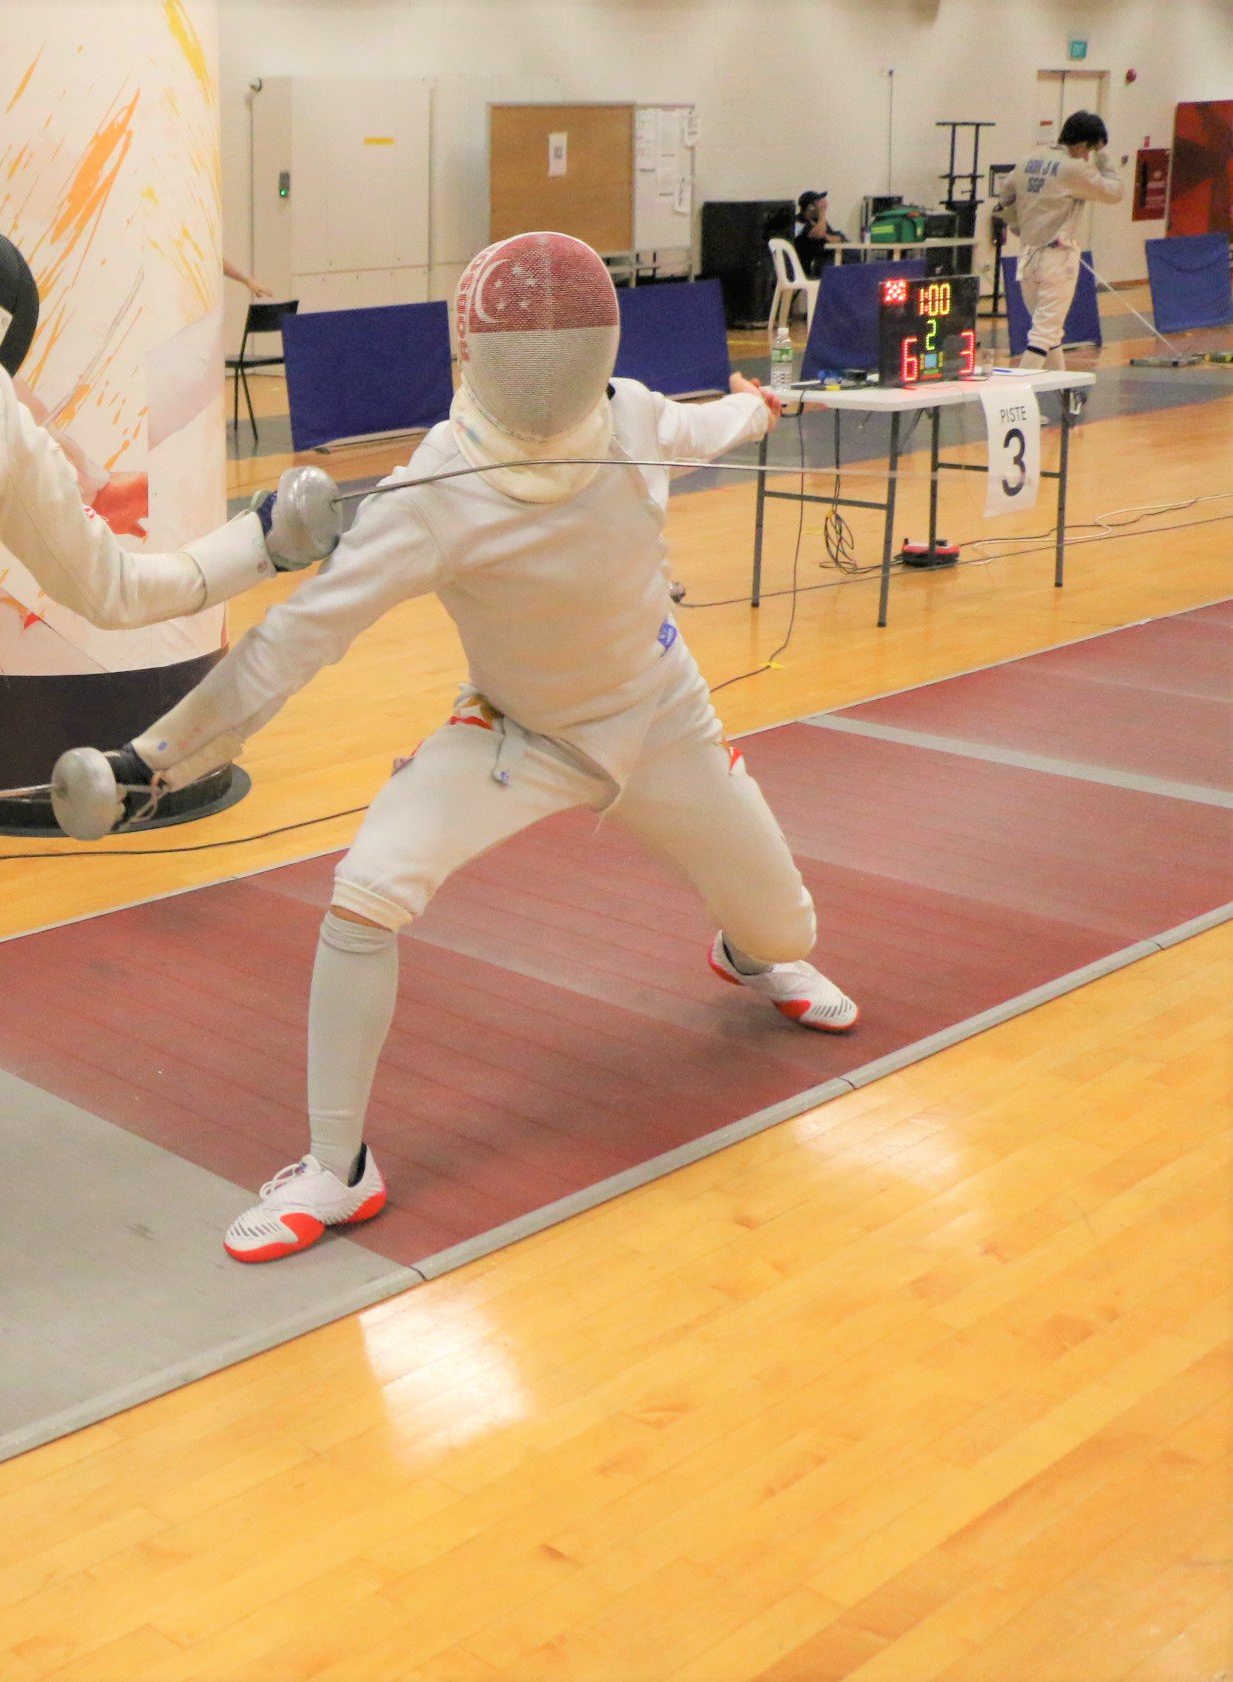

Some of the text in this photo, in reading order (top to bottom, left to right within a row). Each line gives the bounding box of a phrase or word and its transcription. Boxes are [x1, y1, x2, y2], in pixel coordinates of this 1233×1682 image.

[918, 282, 951, 316] 1:00
[925, 319, 937, 351] 2
[958, 328, 976, 376] 3
[900, 336, 919, 383] 6
[1000, 405, 1028, 424] PISTE
[1002, 428, 1027, 497] 3
